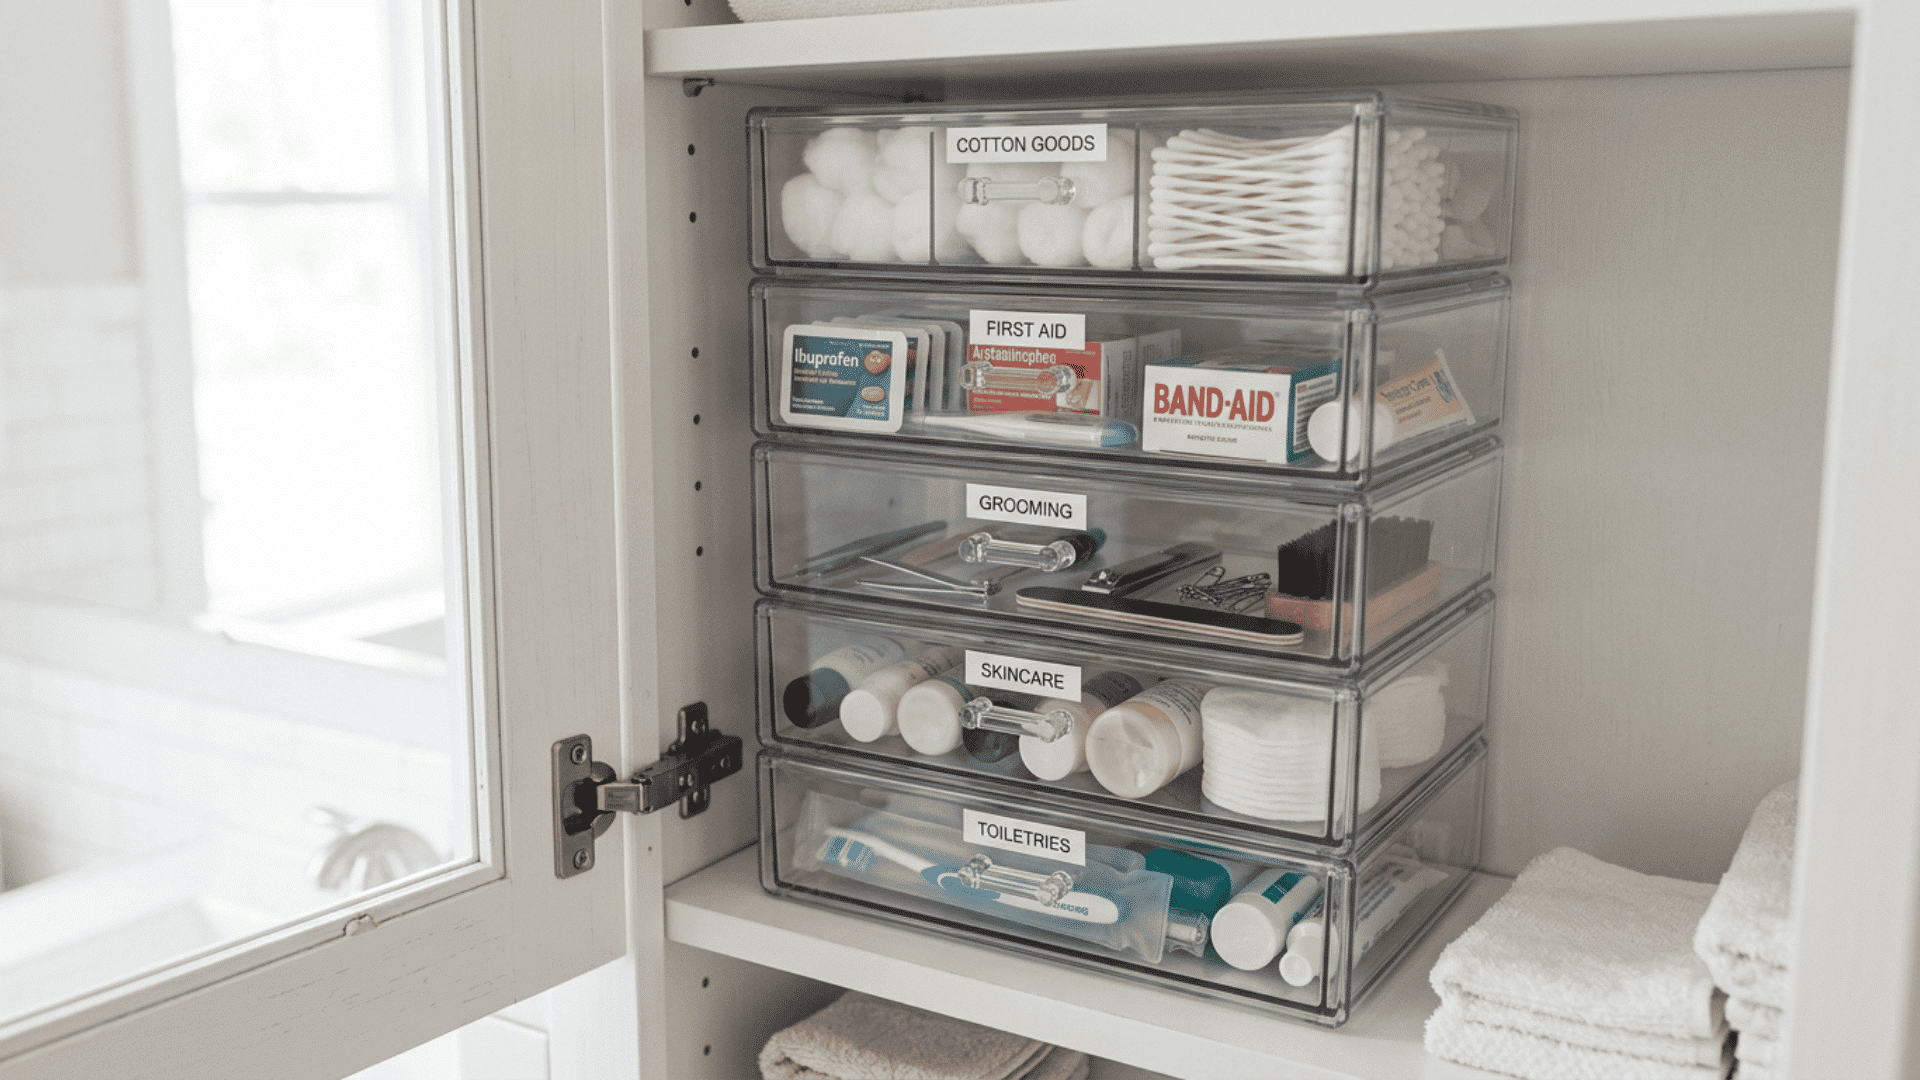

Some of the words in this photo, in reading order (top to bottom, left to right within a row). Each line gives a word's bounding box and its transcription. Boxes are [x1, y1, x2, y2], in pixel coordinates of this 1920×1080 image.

[957, 137, 1026, 153] COTTON
[1031, 135, 1095, 152] GOODS
[987, 320, 1034, 337] FIRST
[1038, 323, 1067, 339] AID
[980, 495, 1072, 519] GROOMING
[981, 662, 1064, 690] SKINCARE
[978, 821, 1071, 853] TOILETRIES
